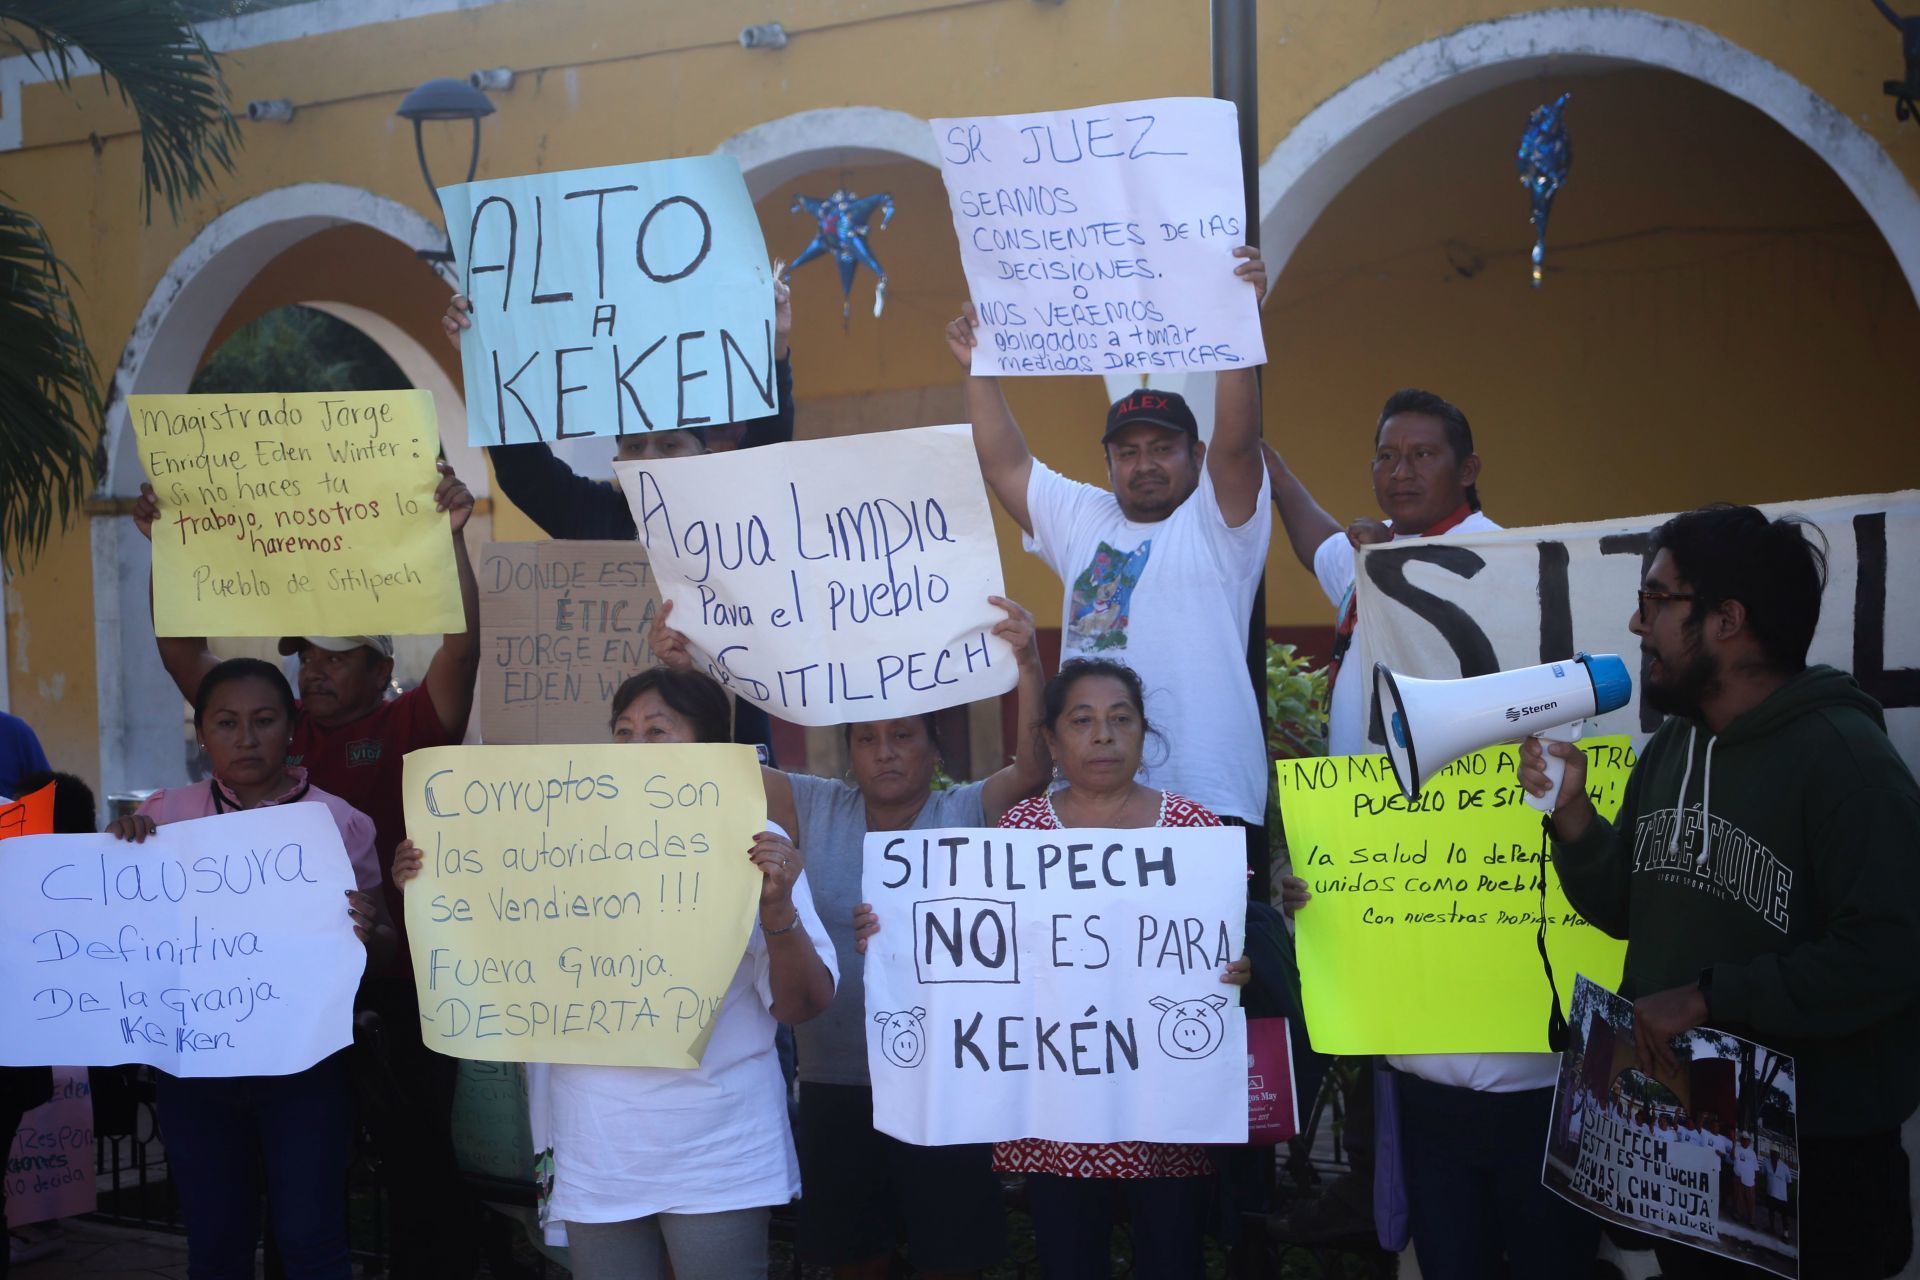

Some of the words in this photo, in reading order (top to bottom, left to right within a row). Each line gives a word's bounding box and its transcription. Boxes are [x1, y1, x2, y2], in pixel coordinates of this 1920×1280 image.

[945, 125, 991, 165] SR
[1020, 115, 1188, 164] JUEZ
[959, 185, 1078, 218] SEAMOS
[467, 185, 712, 314] ALTO
[973, 222, 1146, 252] CONSIENTES
[1160, 223, 1190, 241] DE
[1072, 285, 1088, 299] O
[592, 304, 616, 337] A
[980, 301, 1026, 326] NOS
[1034, 300, 1164, 327] VEREMOS
[995, 328, 1098, 358] obligados
[1108, 331, 1121, 347] a
[1129, 325, 1198, 346] tomar
[998, 353, 1093, 372] medidas
[492, 319, 775, 445] KEKEN
[140, 398, 303, 450] Magistrado
[317, 400, 393, 438] Jorge
[1116, 395, 1169, 417] ALEX
[149, 449, 248, 483] Enrique
[255, 440, 312, 466] Eden
[199, 483, 228, 506] no
[236, 472, 301, 501] haces
[274, 500, 380, 530] nosotros
[395, 492, 418, 516] lo
[638, 471, 776, 582] Agua
[192, 564, 271, 602] Pueblo
[287, 573, 314, 594] de
[485, 555, 586, 594] DONDE
[597, 561, 650, 588] EST
[770, 570, 804, 628] el
[496, 633, 592, 671] JORGE
[717, 632, 992, 708] SITILPECH
[504, 671, 582, 704] EDEN
[1521, 701, 1558, 716] Steren
[1347, 755, 1393, 783] MA
[1440, 753, 1487, 776] ANO
[1496, 751, 1515, 773] A
[424, 760, 620, 827] Corruptos
[1458, 788, 1486, 811] DE
[436, 831, 484, 877] las
[502, 820, 710, 871] autoridades
[882, 837, 1177, 890] SITILPECH
[41, 843, 318, 906] Clausura
[1404, 900, 1488, 925] nuestras
[32, 916, 264, 965] Definitiva
[924, 907, 1007, 968] NO
[1051, 914, 1110, 969] ES
[1137, 915, 1231, 975] PARA
[429, 949, 536, 990] Fuera
[33, 988, 111, 1020] De
[119, 981, 149, 1010] la
[160, 977, 280, 1025] Granja
[953, 1005, 1139, 1076] KEKÉN
[1665, 1165, 1710, 1194] LUCHA
